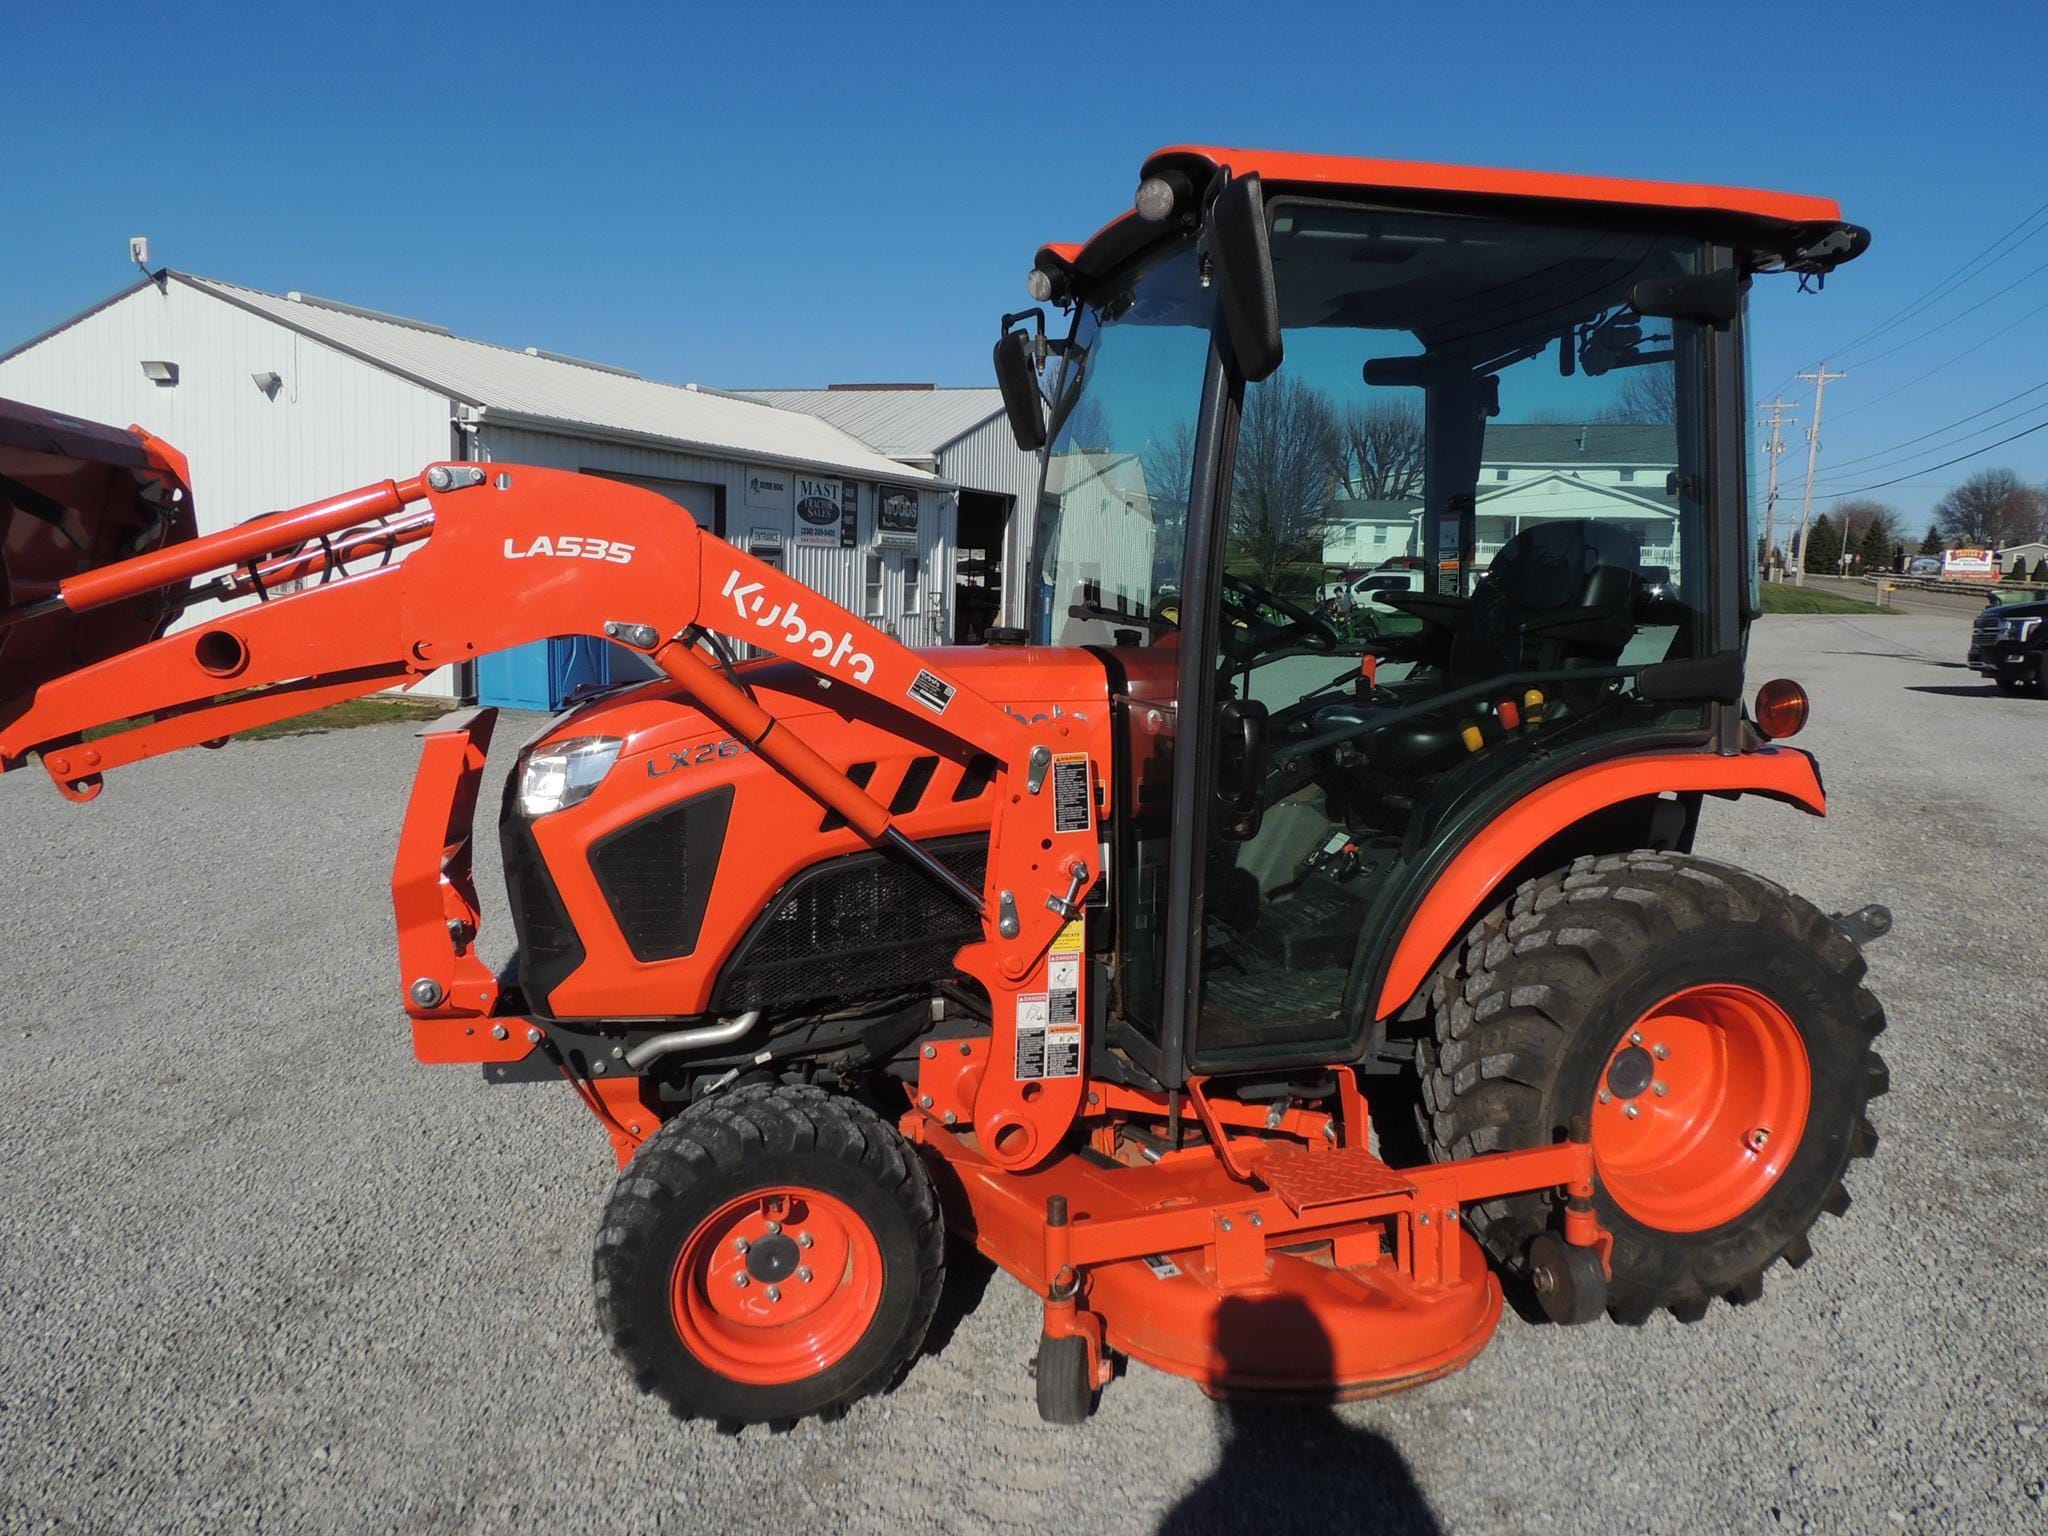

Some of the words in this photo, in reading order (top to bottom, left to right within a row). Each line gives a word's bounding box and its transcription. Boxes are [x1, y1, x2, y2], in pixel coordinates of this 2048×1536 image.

[800, 480, 839, 499] MAST
[804, 496, 833, 509] TRACTOR
[883, 499, 917, 518] WOODS
[807, 507, 831, 518] SALES
[754, 531, 779, 542] ENTRANCE
[503, 536, 636, 564] LA535
[721, 569, 875, 685] Kubota
